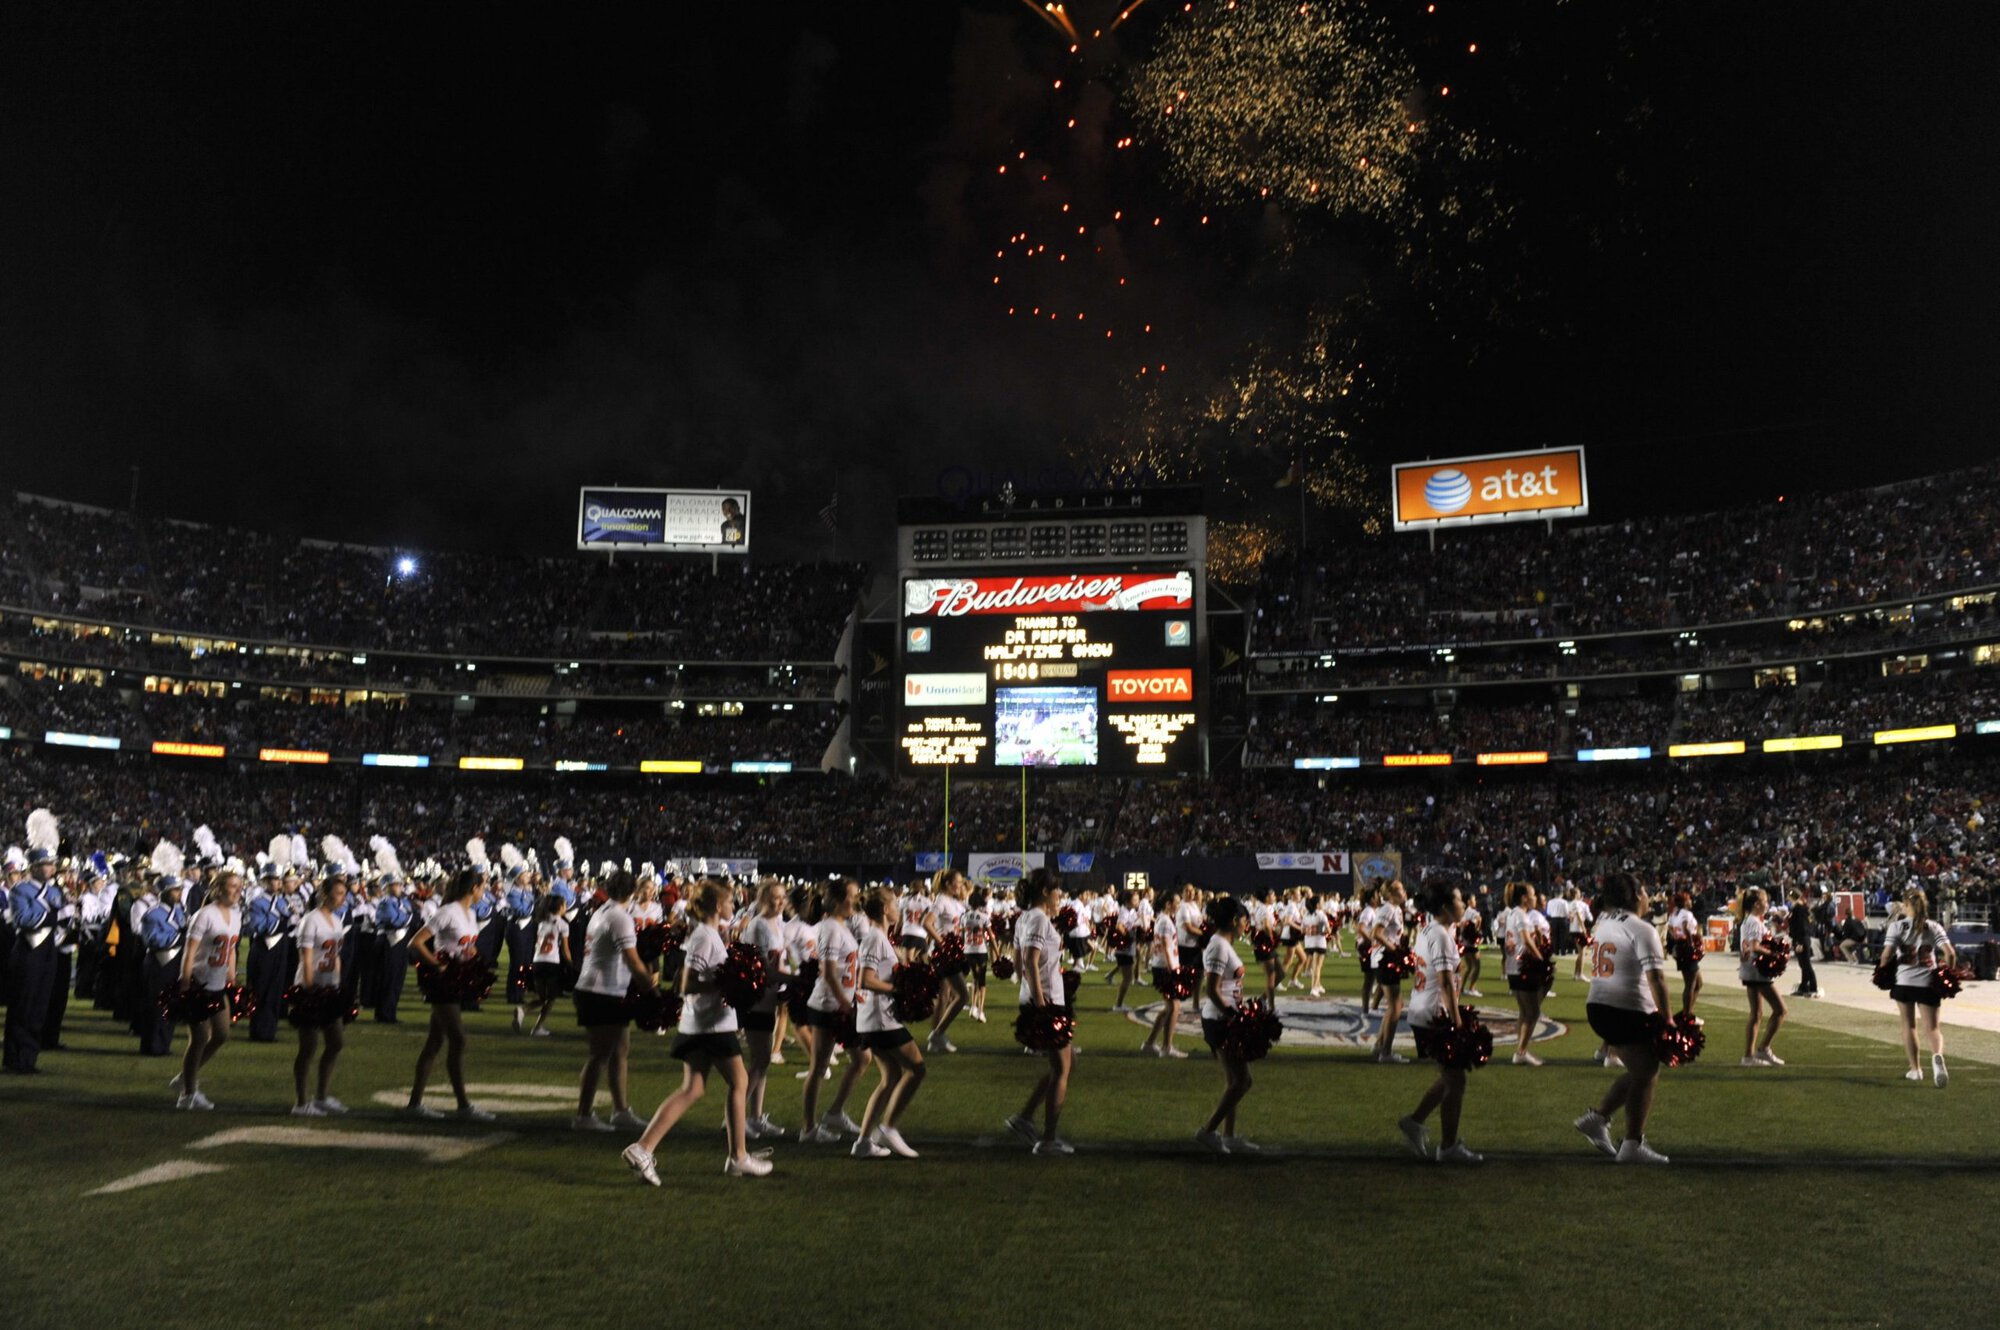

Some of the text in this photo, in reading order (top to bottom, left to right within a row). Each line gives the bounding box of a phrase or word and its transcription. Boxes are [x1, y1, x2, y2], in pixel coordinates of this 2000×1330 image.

[1480, 464, 1559, 501] at&t
[982, 495, 1143, 512] SADIUM
[587, 505, 661, 522] QUALCOMM
[601, 522, 649, 532] innovation
[929, 575, 1122, 616] Budweiser
[1015, 616, 1077, 629] THANKS TO
[1005, 629, 1086, 644] DR PEPPER
[984, 643, 1113, 659] HALFTIME SHOW
[1111, 678, 1188, 695] TOYOTA
[1322, 855, 1342, 872] N
[1127, 872, 1146, 890] 25
